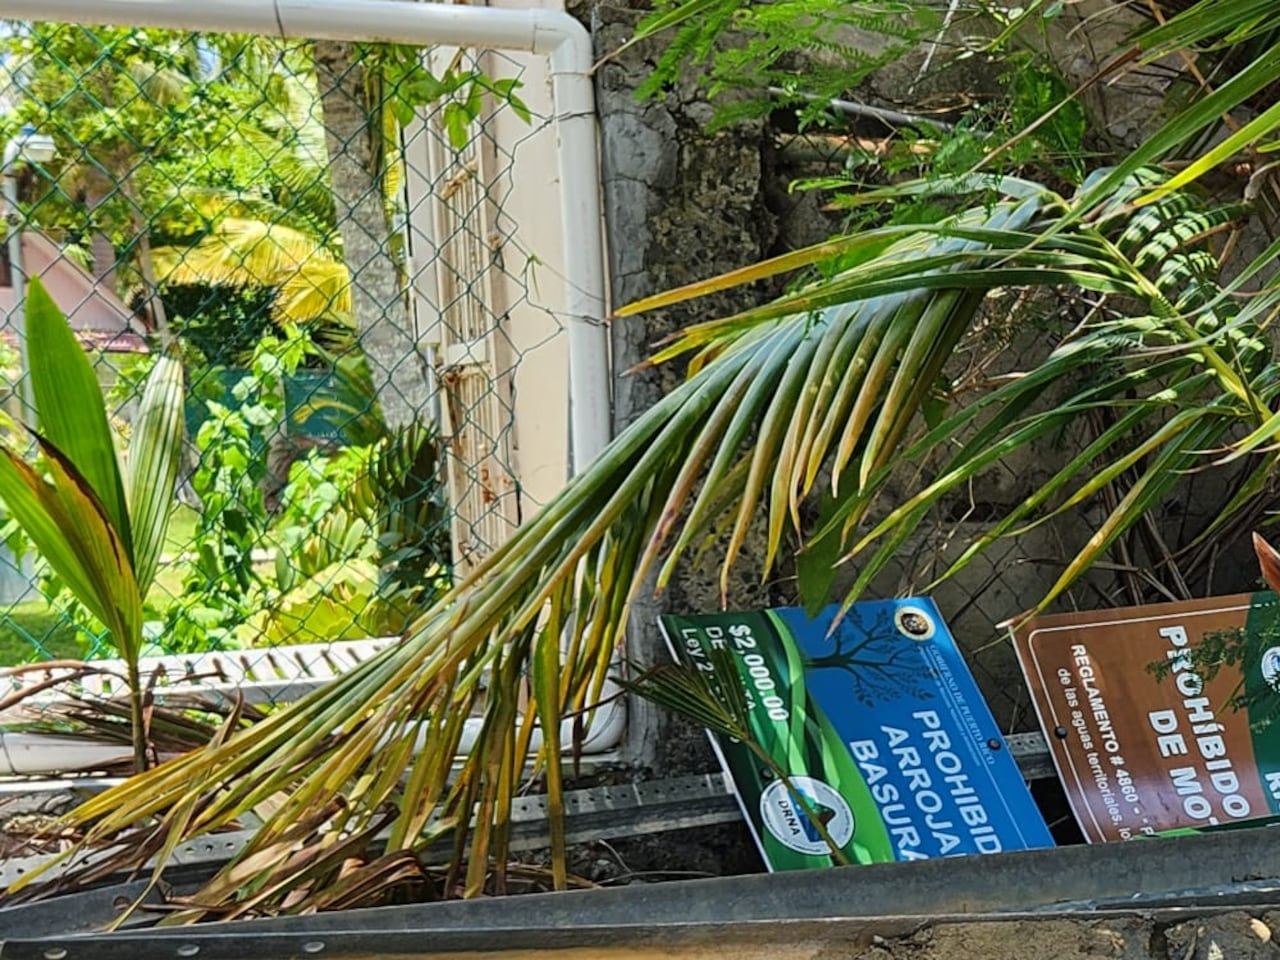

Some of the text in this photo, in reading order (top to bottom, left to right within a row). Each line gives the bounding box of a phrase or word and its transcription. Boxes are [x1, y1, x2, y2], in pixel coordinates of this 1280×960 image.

[682, 628, 705, 658] Ley
[728, 624, 789, 721] $2,000.00
[1057, 667, 1072, 685] de
[1064, 687, 1078, 708] las
[1071, 644, 1120, 753] REGLAMENTO
[1071, 710, 1094, 750] aguas
[1109, 755, 1125, 767] #
[1148, 709, 1219, 825] DE MO
[880, 725, 967, 859] ARROJA
[1087, 752, 1123, 826] territoriales,
[1115, 769, 1139, 802] 4860
[778, 800, 800, 836] DRNA
